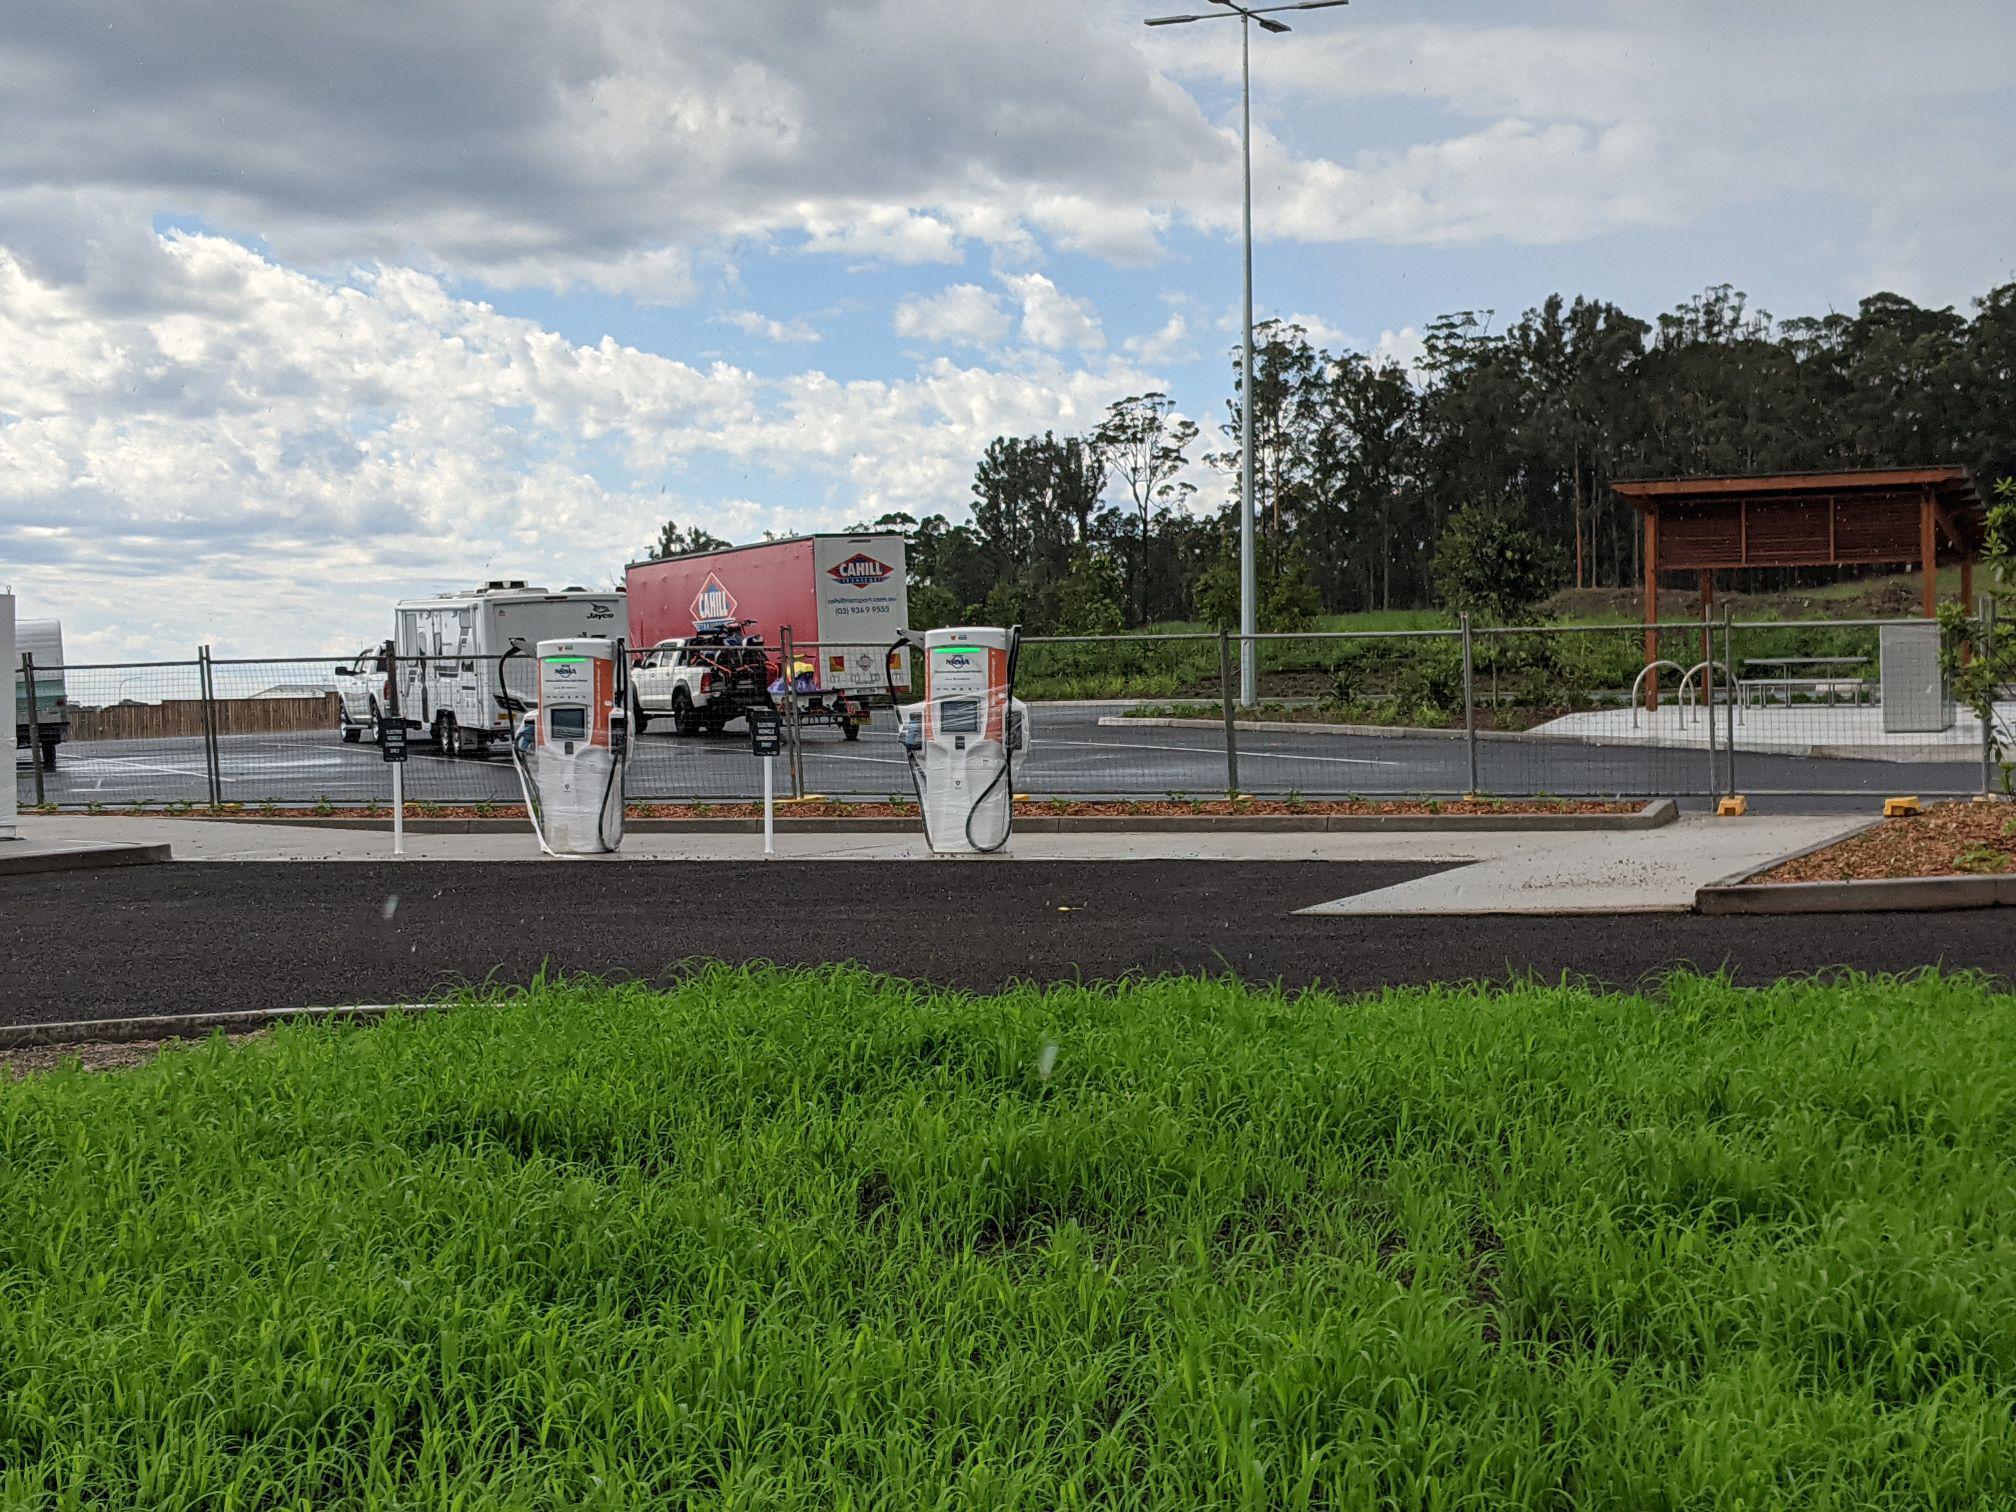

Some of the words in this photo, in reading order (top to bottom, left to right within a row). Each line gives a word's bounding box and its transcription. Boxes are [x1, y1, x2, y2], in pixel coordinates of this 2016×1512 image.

[839, 562, 882, 577] CAHILL
[699, 590, 728, 618] CAHILL
[587, 612, 614, 620] Jayco
